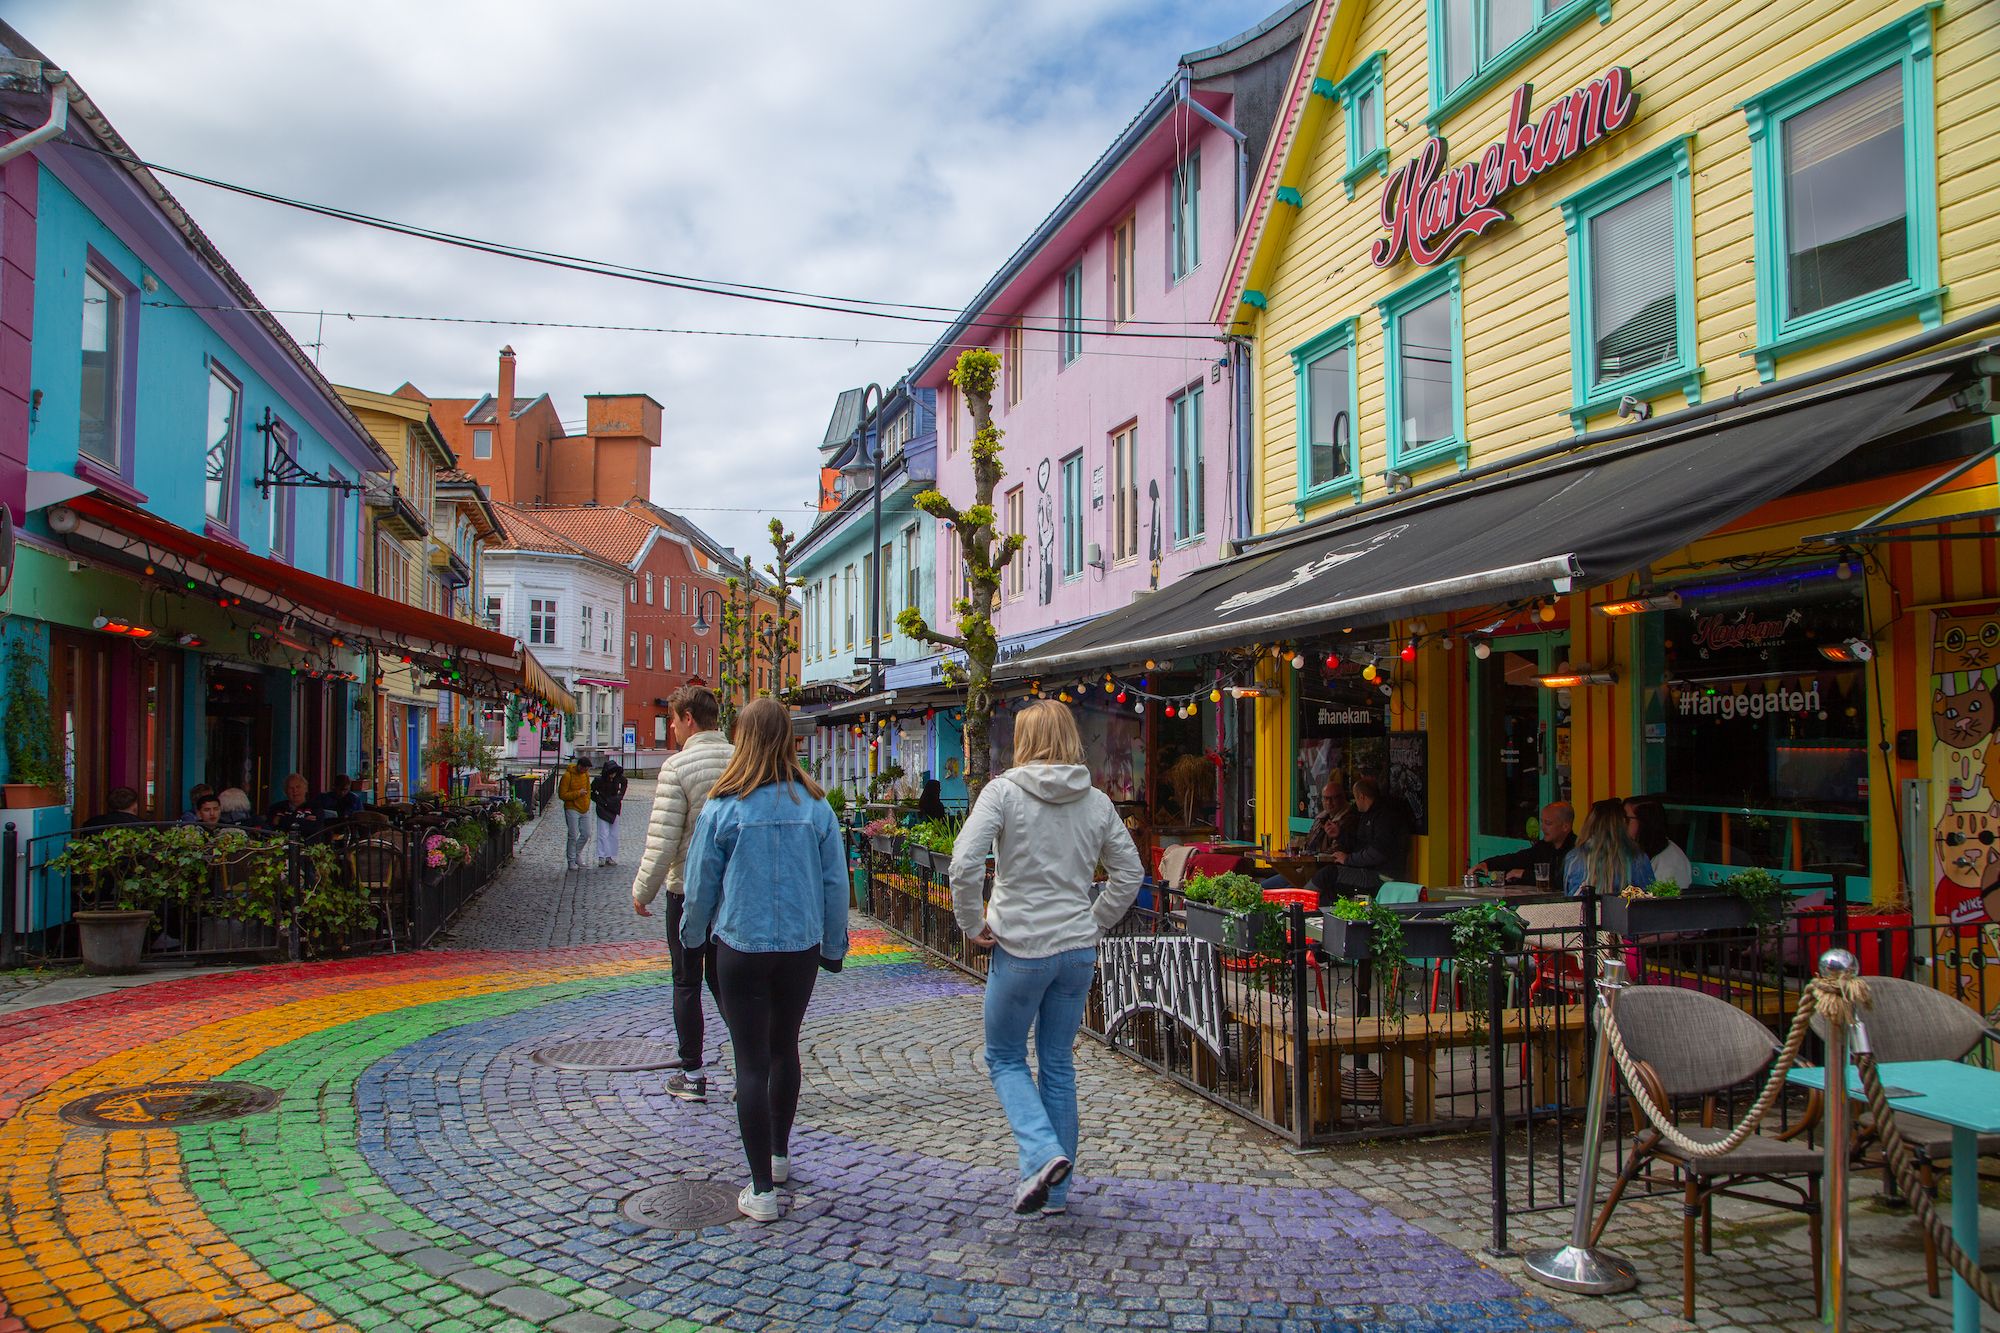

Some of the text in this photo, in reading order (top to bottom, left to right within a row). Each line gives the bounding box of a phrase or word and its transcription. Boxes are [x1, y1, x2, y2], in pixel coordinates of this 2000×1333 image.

[1371, 66, 1636, 269] Hanekam
[1679, 688, 1820, 719] #fargegaten
[1318, 707, 1370, 725] #hanekam
[1960, 897, 1983, 913] NIKE
